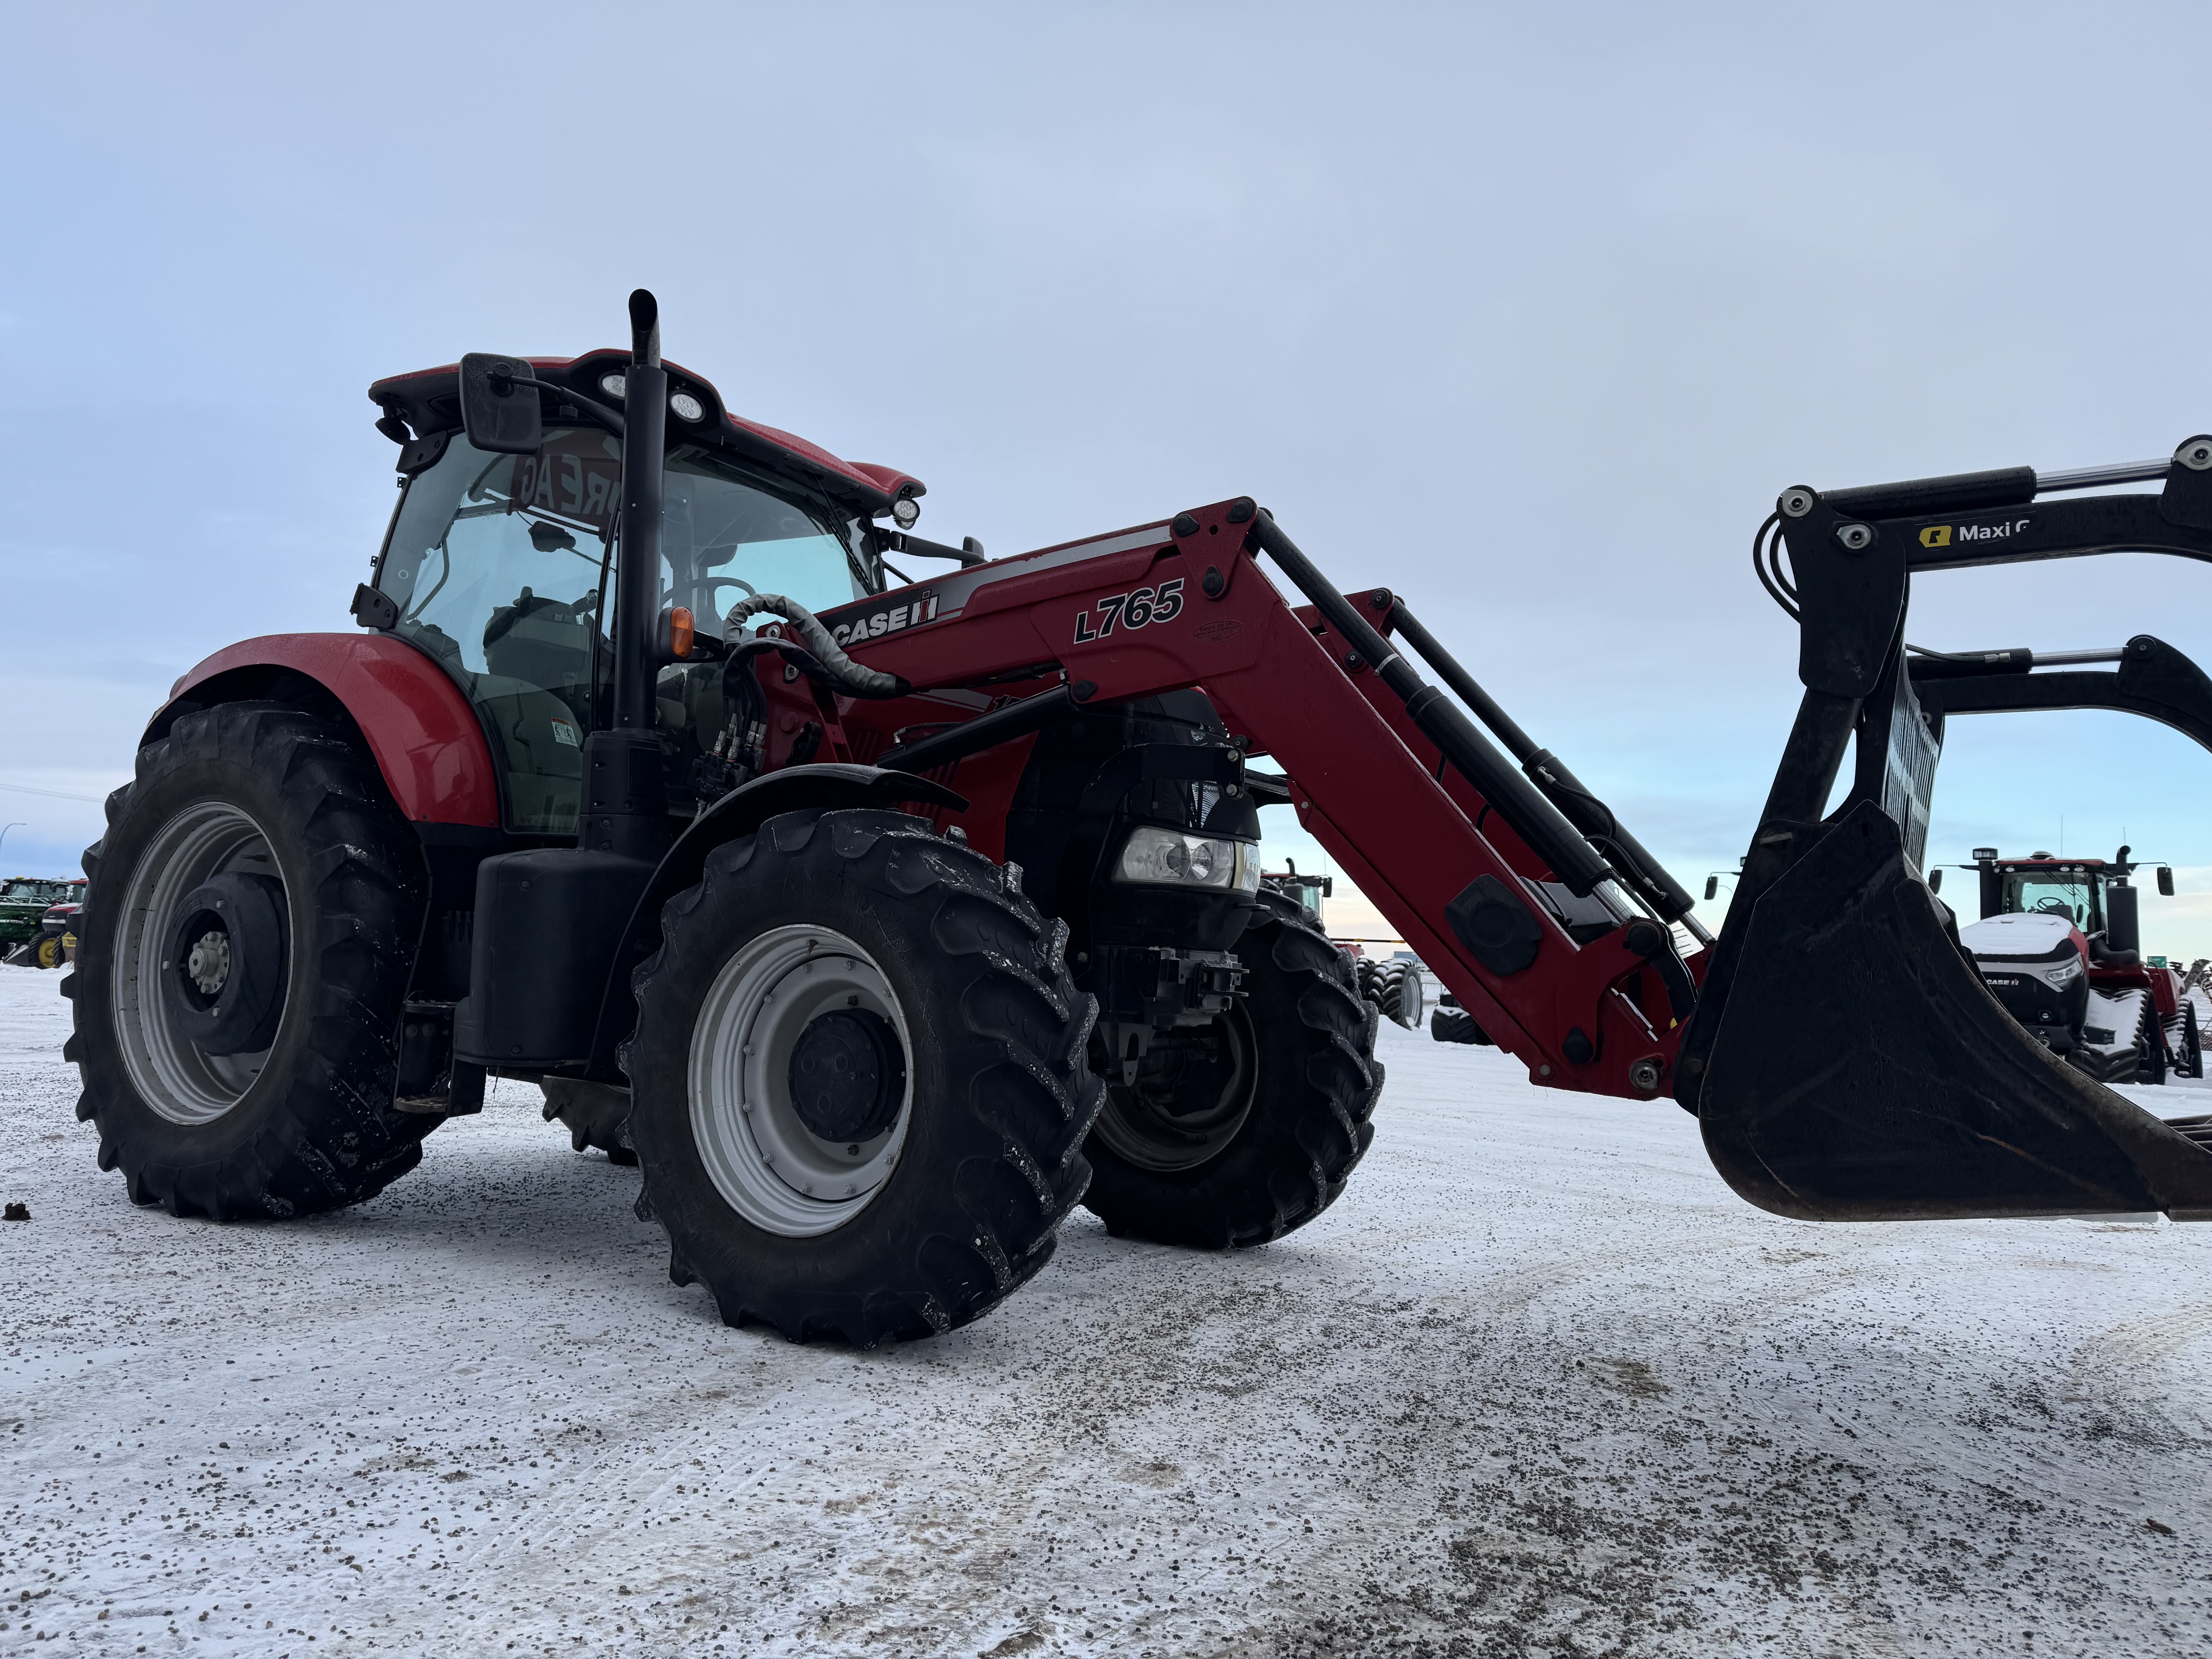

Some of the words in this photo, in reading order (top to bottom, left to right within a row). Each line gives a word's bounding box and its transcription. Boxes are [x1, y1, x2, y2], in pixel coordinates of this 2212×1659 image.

[1960, 522, 2010, 541] Maxi
[831, 605, 908, 647] CASE
[1073, 577, 1185, 645] L765
